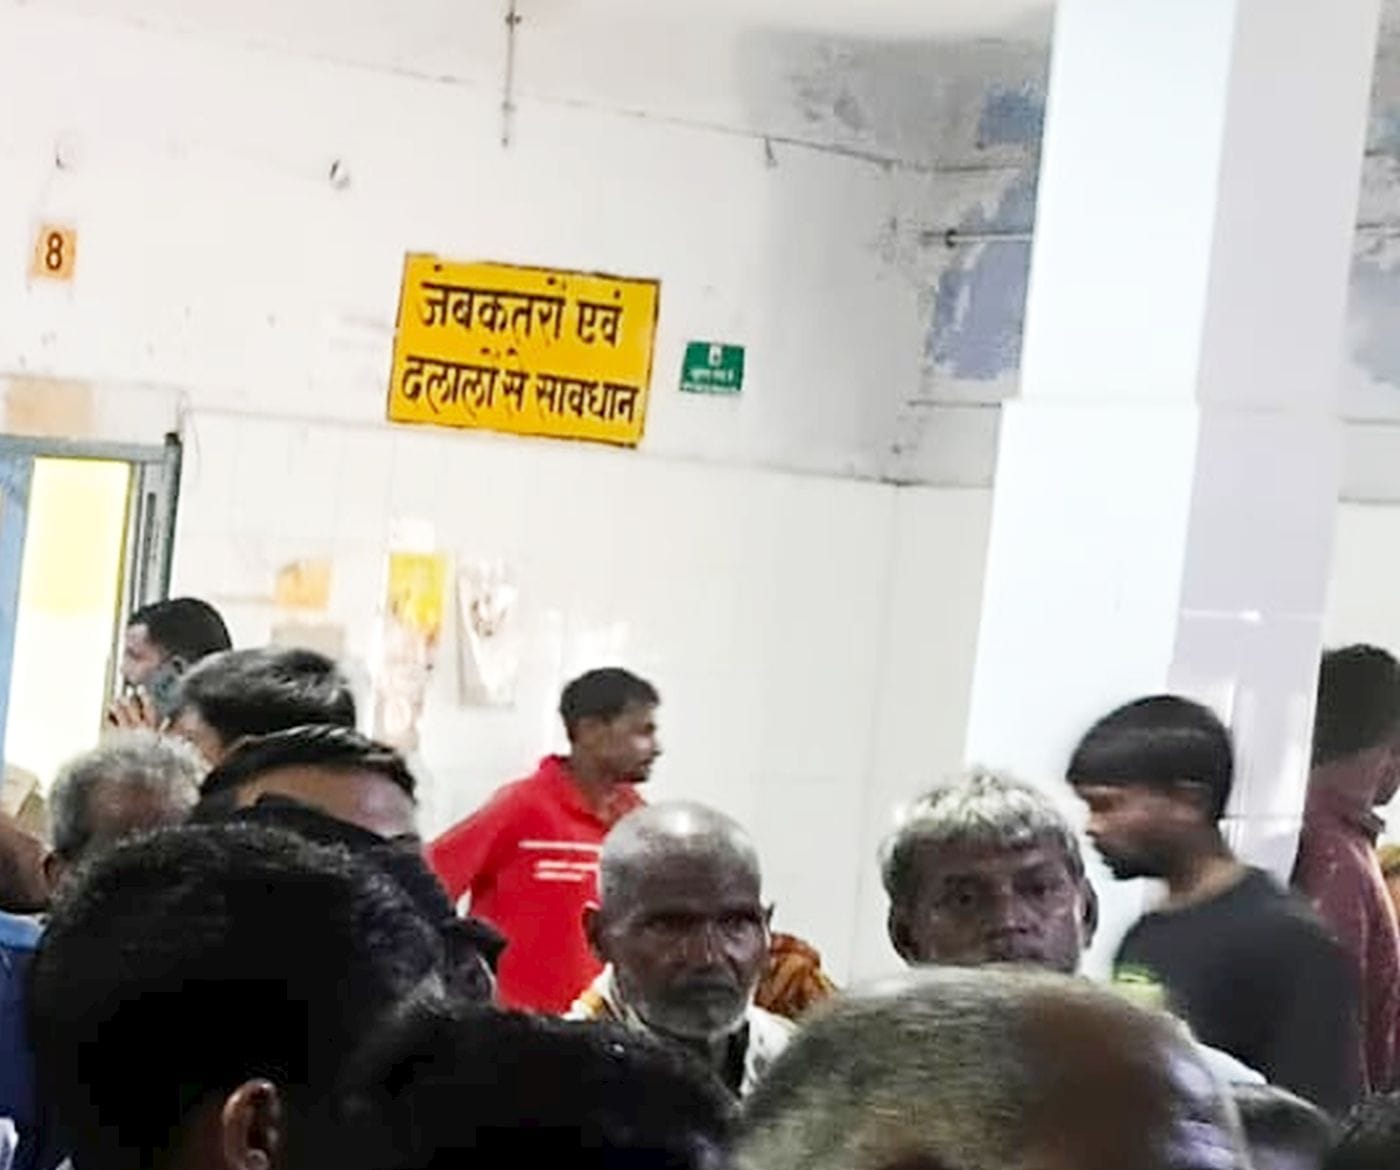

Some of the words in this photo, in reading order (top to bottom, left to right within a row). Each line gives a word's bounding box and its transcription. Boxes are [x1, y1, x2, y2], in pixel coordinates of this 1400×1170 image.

[46, 232, 63, 271] 8
[576, 288, 623, 346] एवं
[536, 371, 640, 424] सावधान
